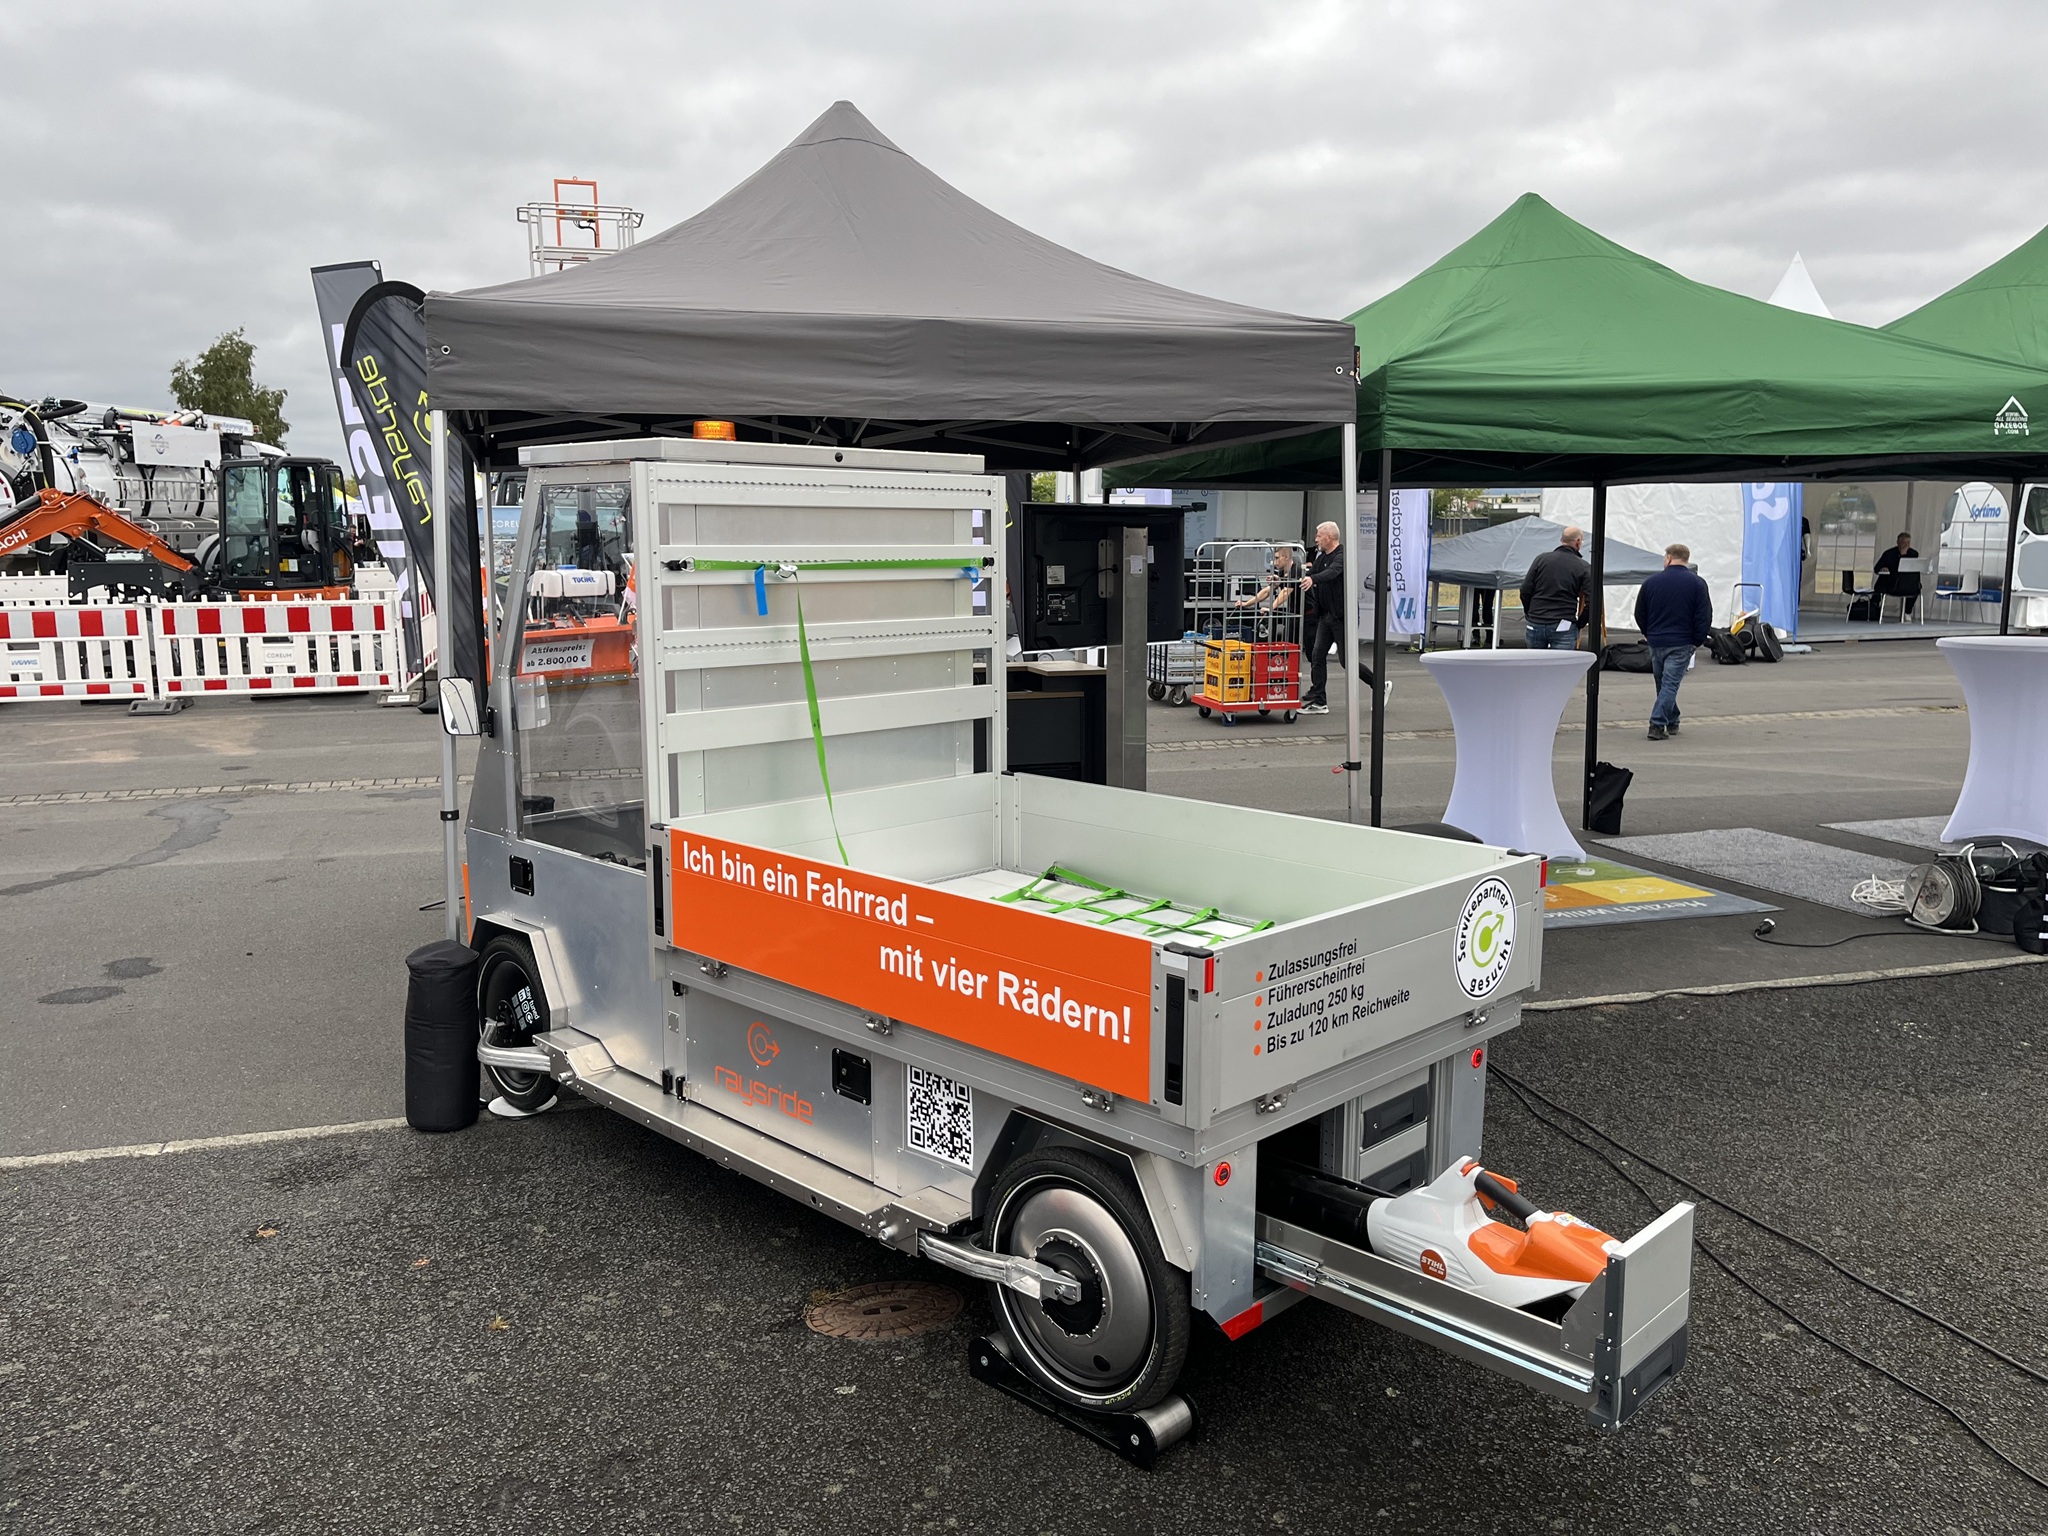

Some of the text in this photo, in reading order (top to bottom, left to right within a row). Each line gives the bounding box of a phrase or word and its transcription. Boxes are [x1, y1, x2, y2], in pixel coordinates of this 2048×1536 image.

[1970, 504, 2002, 518] Sortimo
[531, 644, 586, 655] Aktionspreis:
[538, 655, 579, 666] 2.800,00
[683, 841, 714, 876] Ich
[721, 852, 755, 887] bin
[762, 862, 798, 898] ein
[806, 871, 908, 926] Fahrrad
[1458, 885, 1509, 962] Servicepartner
[1268, 938, 1357, 982] Zulassungsfrei
[1268, 958, 1365, 1006] Führerscheinfrei
[1470, 939, 1511, 993] gesucht
[880, 945, 1131, 1044] mit vier Rädern!
[1267, 982, 1364, 1030] Zuladung 250 kg
[1267, 988, 1410, 1054] Bis zu 120 km Reichweite
[715, 1065, 814, 1126] raysride
[1421, 1256, 1445, 1271] STIHL
[1105, 1390, 1131, 1404] PICK-UP
